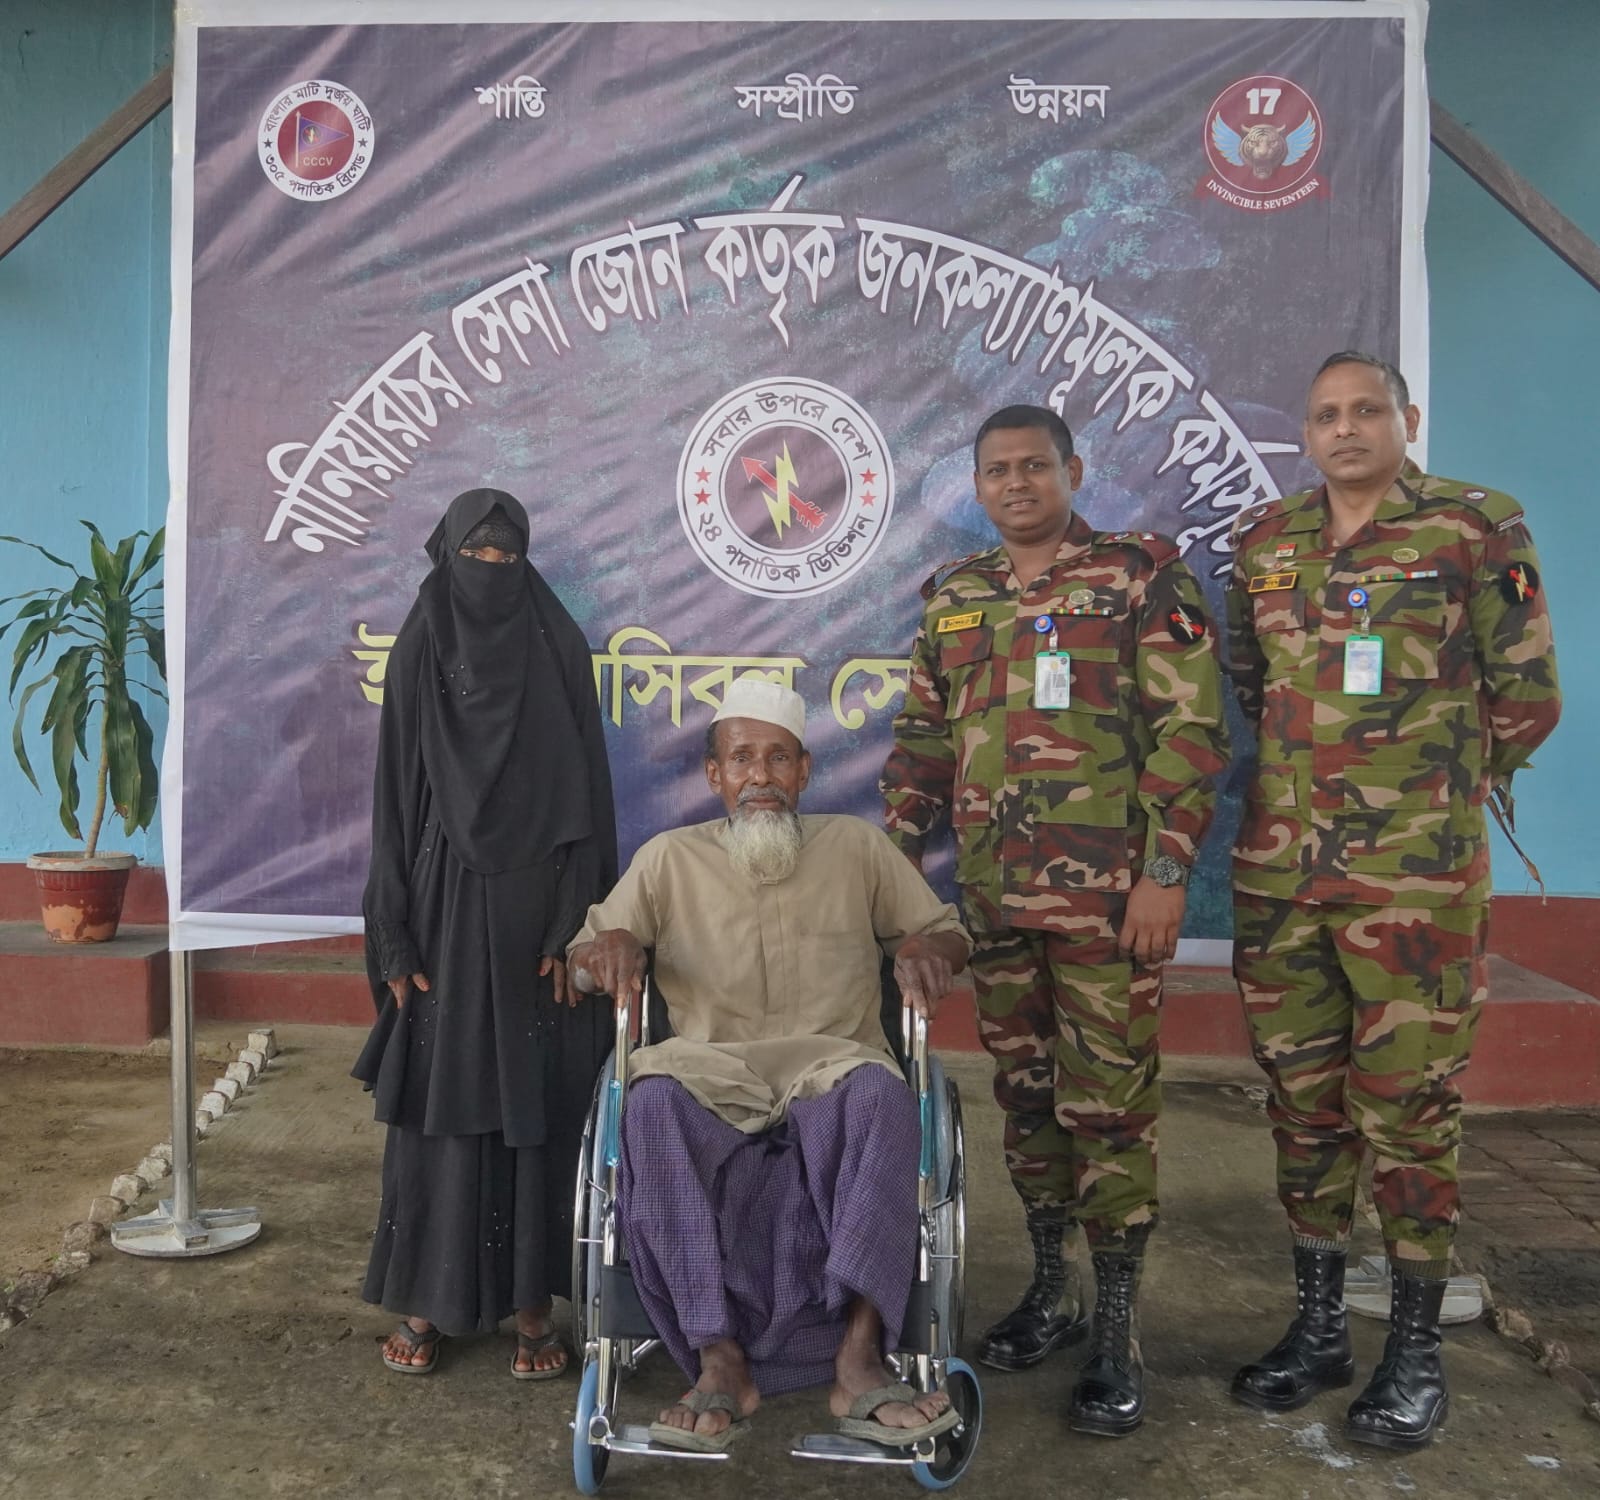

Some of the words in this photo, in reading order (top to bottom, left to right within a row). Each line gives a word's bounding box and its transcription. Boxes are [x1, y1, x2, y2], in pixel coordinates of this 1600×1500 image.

[292, 82, 321, 98] মাটি
[474, 75, 546, 119] শান্তি
[733, 73, 858, 122] সম্প্রীতি
[1007, 74, 1110, 123] উন্নয়ন
[1246, 88, 1281, 115] 17
[266, 154, 284, 181] ৩০৫
[289, 181, 335, 197] পদাতিক
[336, 154, 365, 187] ব্রিগেড
[303, 157, 333, 167] CCCV
[1206, 179, 1262, 209] INVINCIBLE
[1264, 178, 1320, 209] SEVENTEEN
[264, 331, 472, 552] নানিয়ারচর
[452, 257, 571, 383] সেনা
[570, 220, 689, 332] জোন
[694, 175, 845, 347] কর্তৃক
[855, 217, 1194, 431] জনকল্যাণমূলক
[700, 406, 752, 456] সবার
[755, 392, 829, 421] উপরে
[832, 417, 873, 460] দেশ
[699, 512, 722, 542] ২৪
[726, 544, 801, 583] পদাতিক
[807, 513, 874, 578] ডিভিশন
